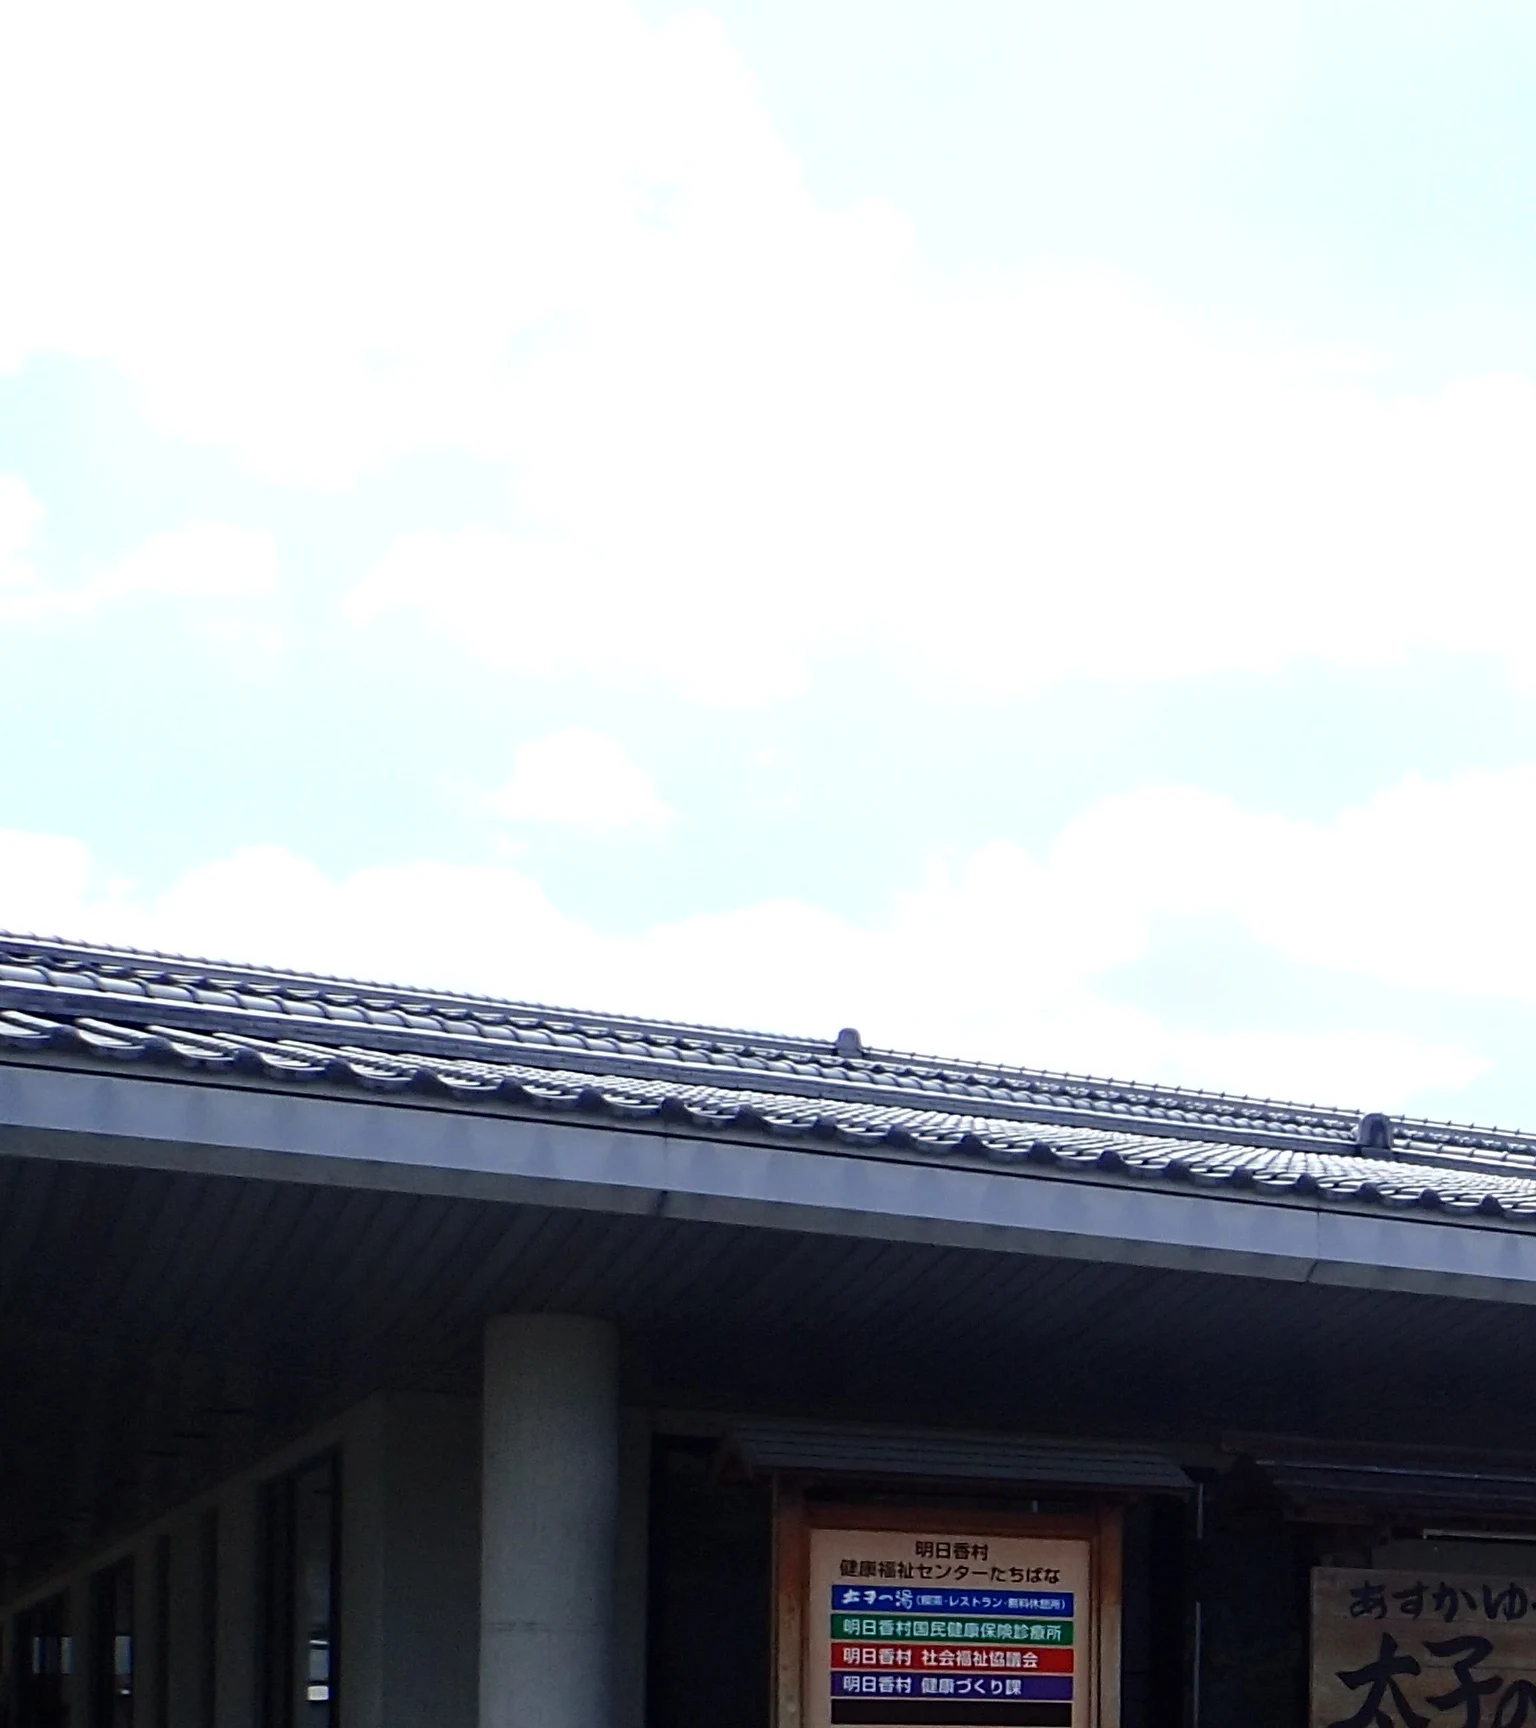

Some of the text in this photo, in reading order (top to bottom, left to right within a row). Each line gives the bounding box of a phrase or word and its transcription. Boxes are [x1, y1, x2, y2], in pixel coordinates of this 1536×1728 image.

[915, 1541, 989, 1561] 明日香村
[840, 1559, 1061, 1584] 健康福祉センターたちばな
[843, 1618, 1062, 1642] 明日香村国民健康保険診療所
[843, 1647, 1039, 1670] 明日香村 社会福祉協議会
[843, 1675, 1023, 1697] 明日香村 健康づくり課
